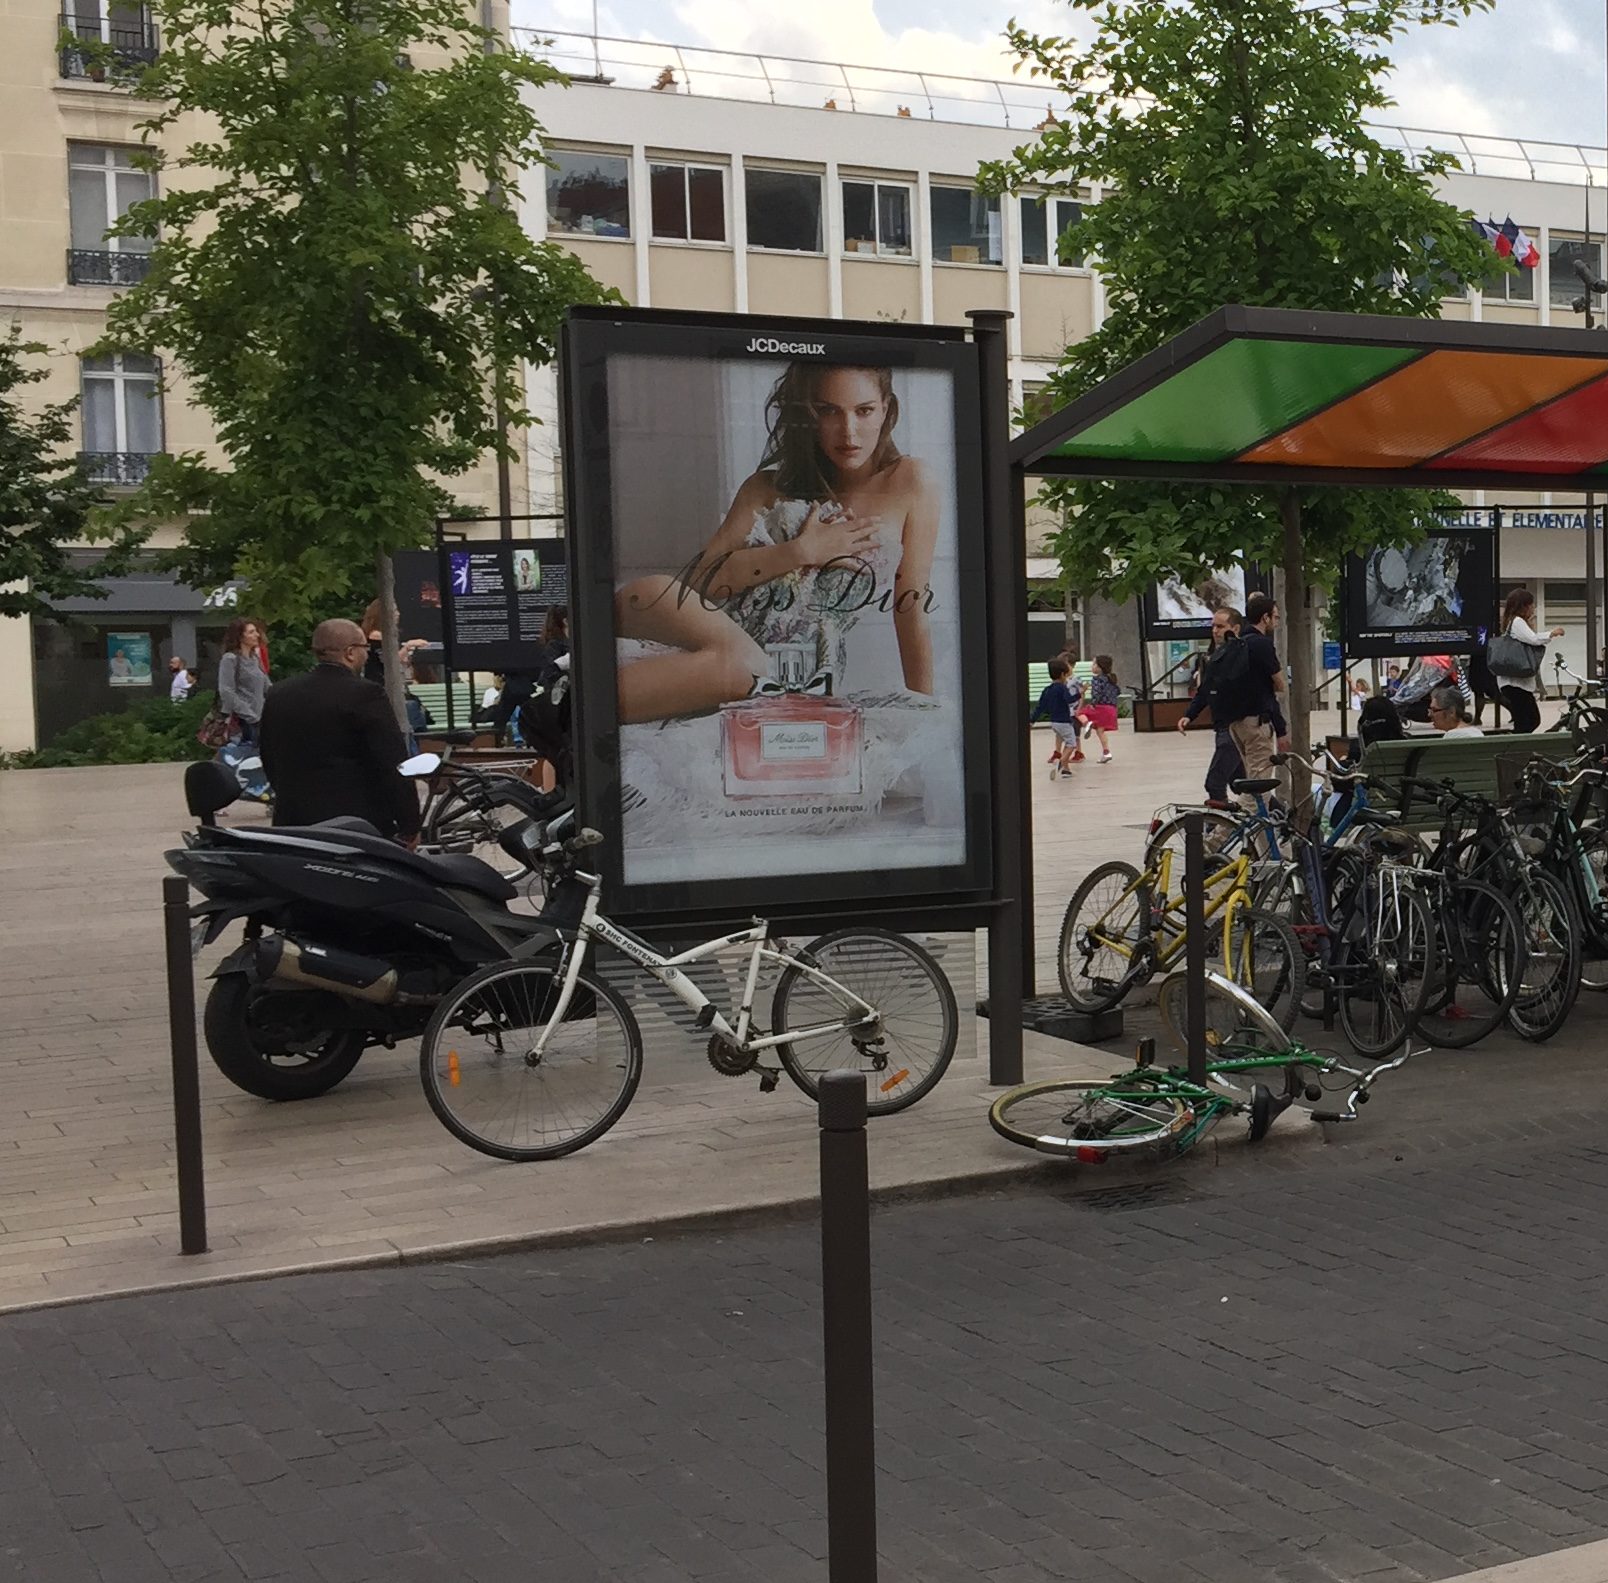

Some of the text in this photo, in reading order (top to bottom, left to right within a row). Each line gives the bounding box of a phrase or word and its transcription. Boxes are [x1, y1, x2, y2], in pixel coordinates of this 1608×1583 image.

[746, 338, 826, 355] JCDecaux
[1513, 512, 1604, 528] ELEMENTAIE
[629, 550, 795, 612] Miss
[807, 555, 941, 614] Dior
[725, 809, 736, 818] LA
[740, 807, 787, 817] NOUVELLE
[791, 807, 808, 815] EAU
[812, 806, 823, 814] DE
